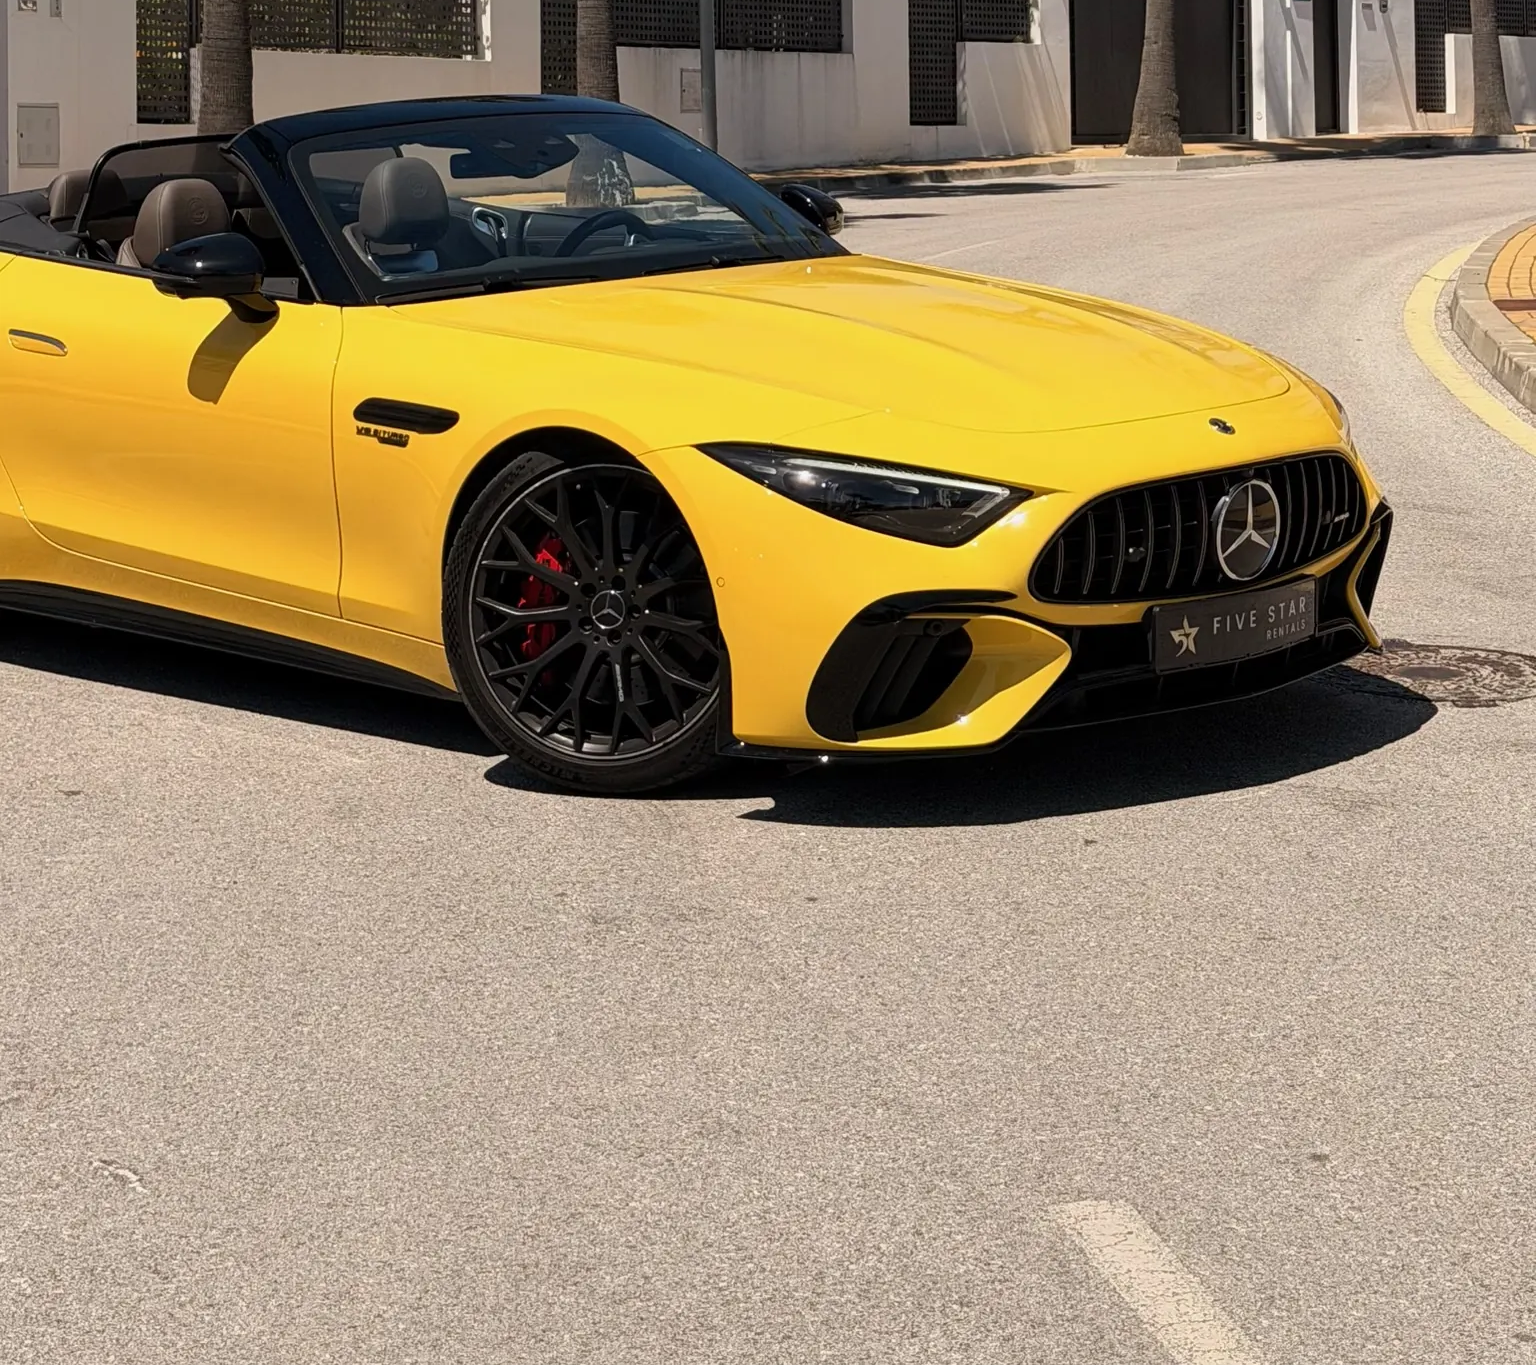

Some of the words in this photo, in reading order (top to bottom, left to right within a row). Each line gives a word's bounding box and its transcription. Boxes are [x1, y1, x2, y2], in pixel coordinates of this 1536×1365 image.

[1213, 610, 1257, 635] FIVE
[1267, 596, 1306, 623] STAR
[1266, 618, 1306, 641] RENTALS
